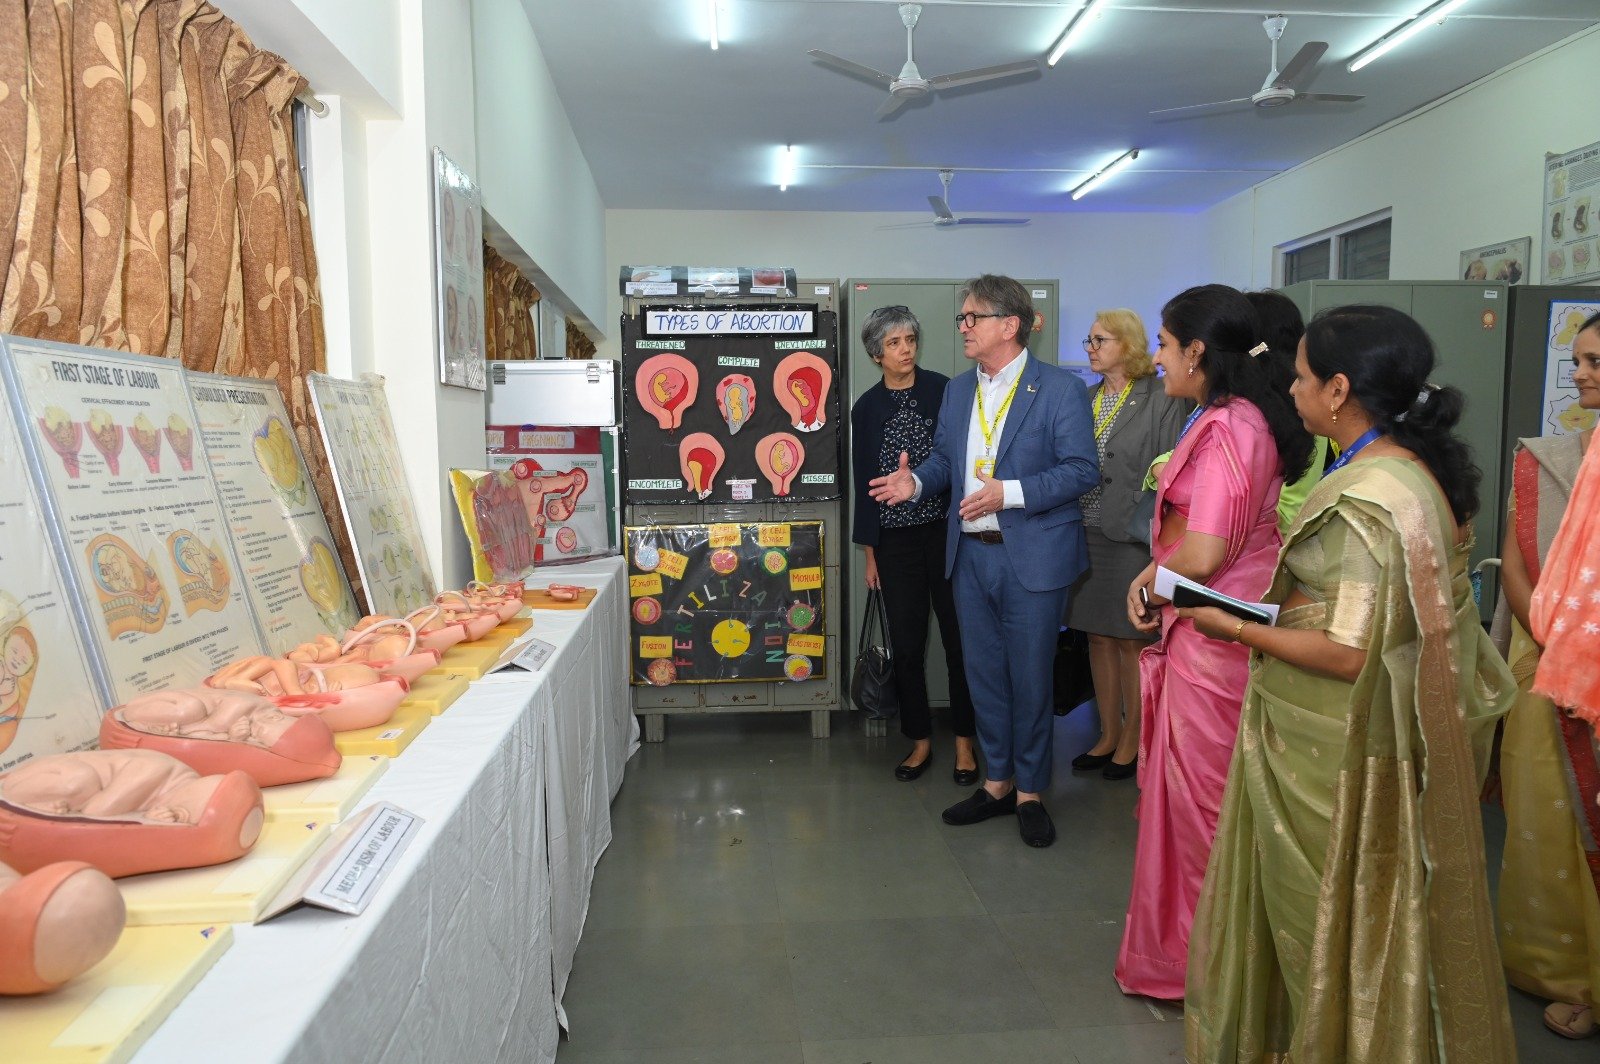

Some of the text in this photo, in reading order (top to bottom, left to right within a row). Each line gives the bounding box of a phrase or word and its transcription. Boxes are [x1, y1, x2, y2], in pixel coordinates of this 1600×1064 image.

[1565, 154, 1582, 166] CHANGES
[1583, 149, 1598, 159] DURING
[655, 313, 807, 331] TYPES OF ABORTION
[636, 340, 686, 349] THREATENED
[776, 340, 826, 349] INEVITABLE
[718, 356, 759, 367] COMPLETE
[52, 361, 160, 389] FIRST STAGE OF LABOUR
[522, 434, 566, 447] PREGNANCY
[802, 474, 834, 483] MISSED
[629, 480, 682, 489] INCOMPLETE
[770, 527, 787, 535] CELL
[668, 555, 683, 564] CELL
[632, 579, 658, 588] ZYGOTE
[641, 641, 667, 650] FUSION
[371, 839, 381, 852] OF
[378, 815, 402, 841] LABOUR
